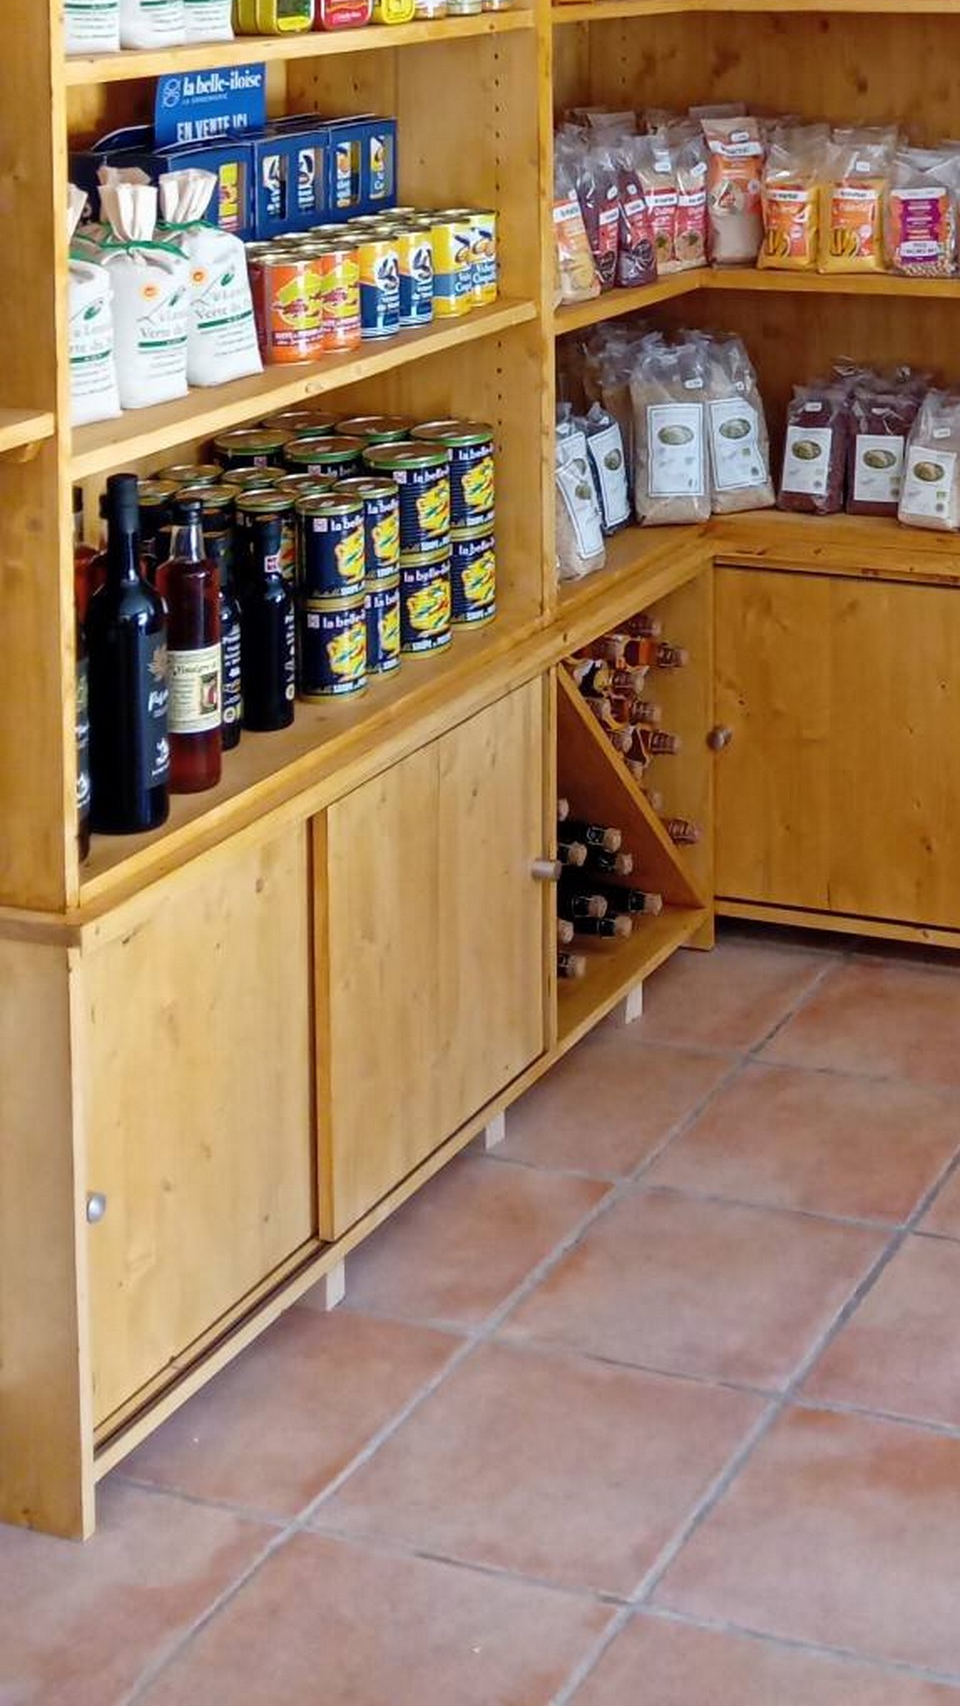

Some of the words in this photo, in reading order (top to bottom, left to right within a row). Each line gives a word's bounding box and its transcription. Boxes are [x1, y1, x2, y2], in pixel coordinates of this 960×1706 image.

[183, 76, 195, 96] la
[196, 69, 262, 94] belle-iloise
[177, 122, 192, 142] EN
[195, 115, 230, 139] VENTE
[233, 113, 248, 128] ICI
